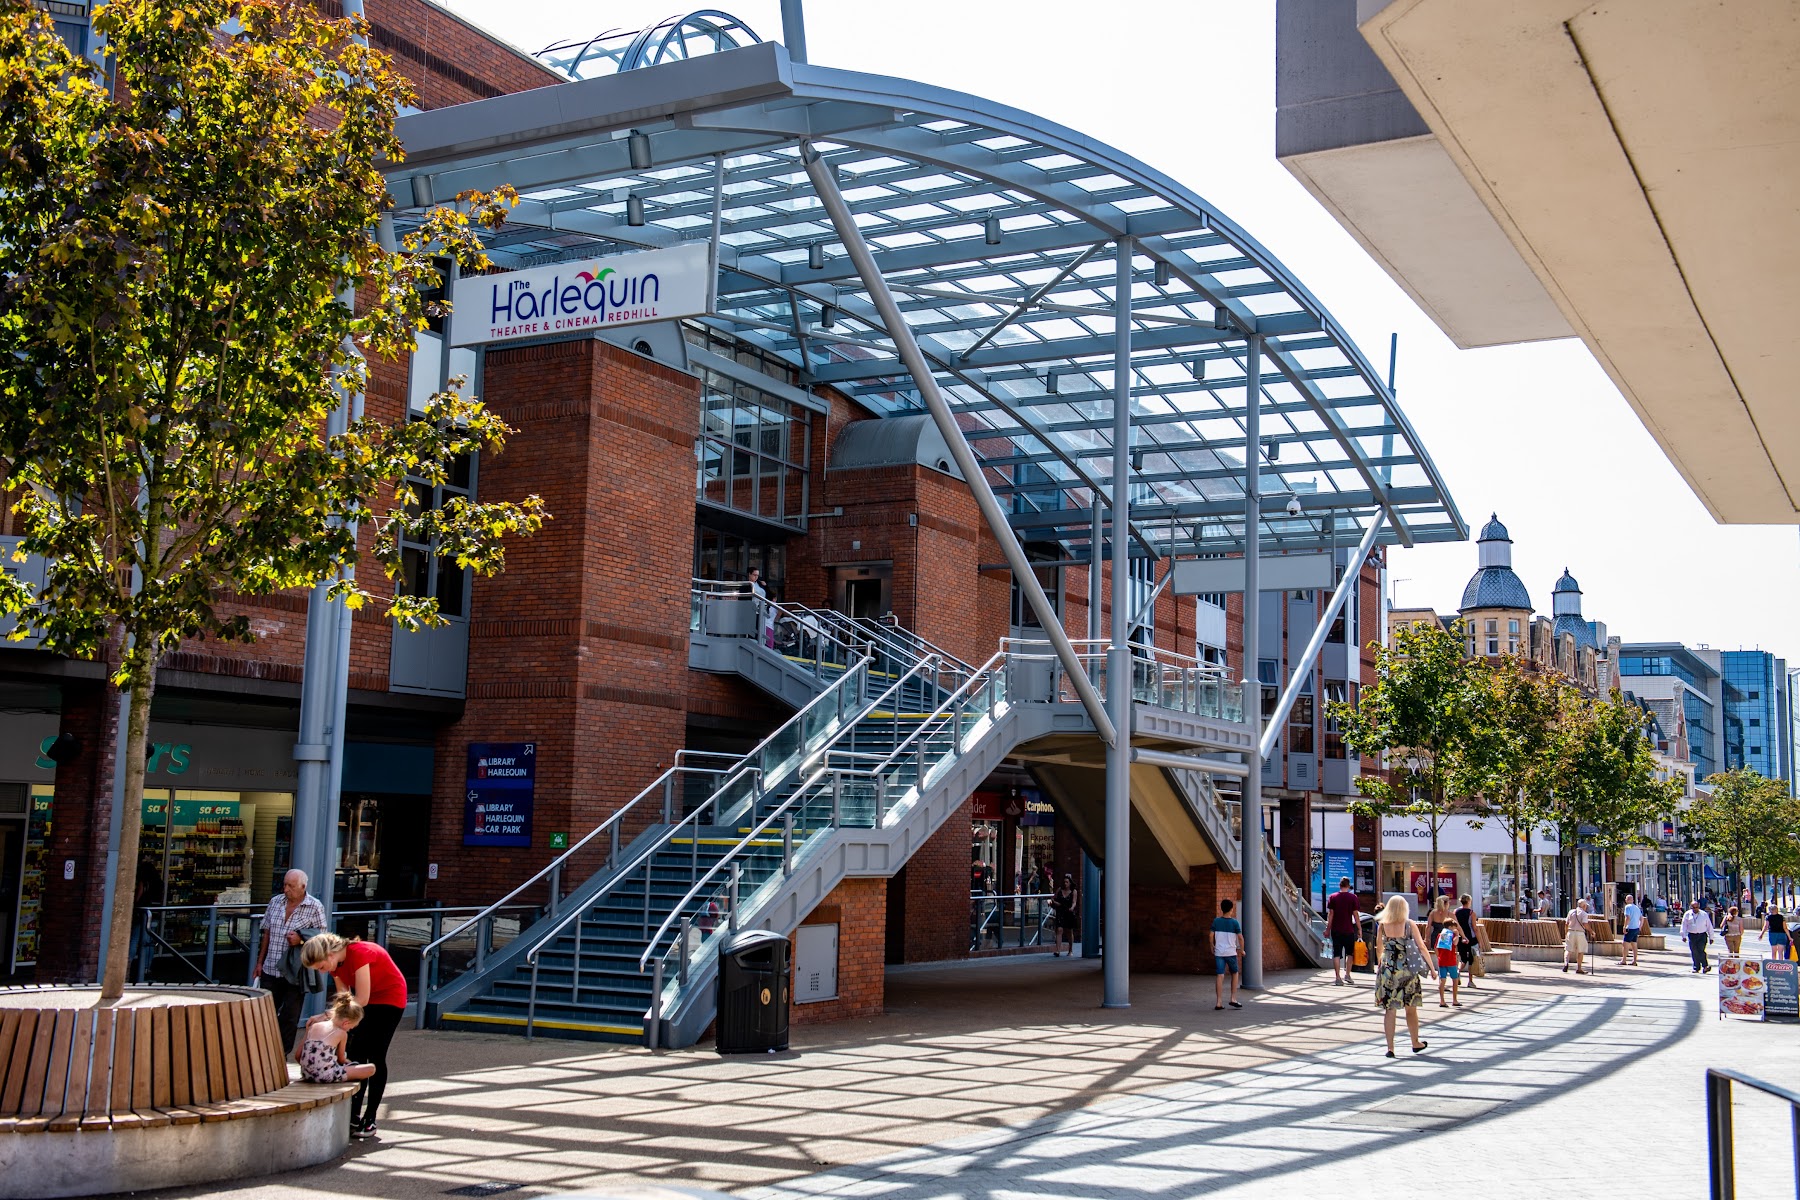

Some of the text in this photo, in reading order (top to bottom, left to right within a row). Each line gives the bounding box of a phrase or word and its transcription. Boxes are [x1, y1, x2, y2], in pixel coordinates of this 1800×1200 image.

[513, 280, 530, 291] The
[491, 273, 660, 323] Harlequin
[490, 307, 658, 338] THEATRE & CINEMA REDHILL
[488, 757, 516, 766] LIBRARY
[487, 768, 527, 777] HARLEQUIN
[147, 804, 181, 814] saves
[199, 804, 231, 815] savers
[486, 803, 514, 812] LIBRARY
[485, 814, 525, 823] HARLEQUIN
[485, 825, 521, 834] CAR PARK
[1412, 828, 1432, 838] Coo
